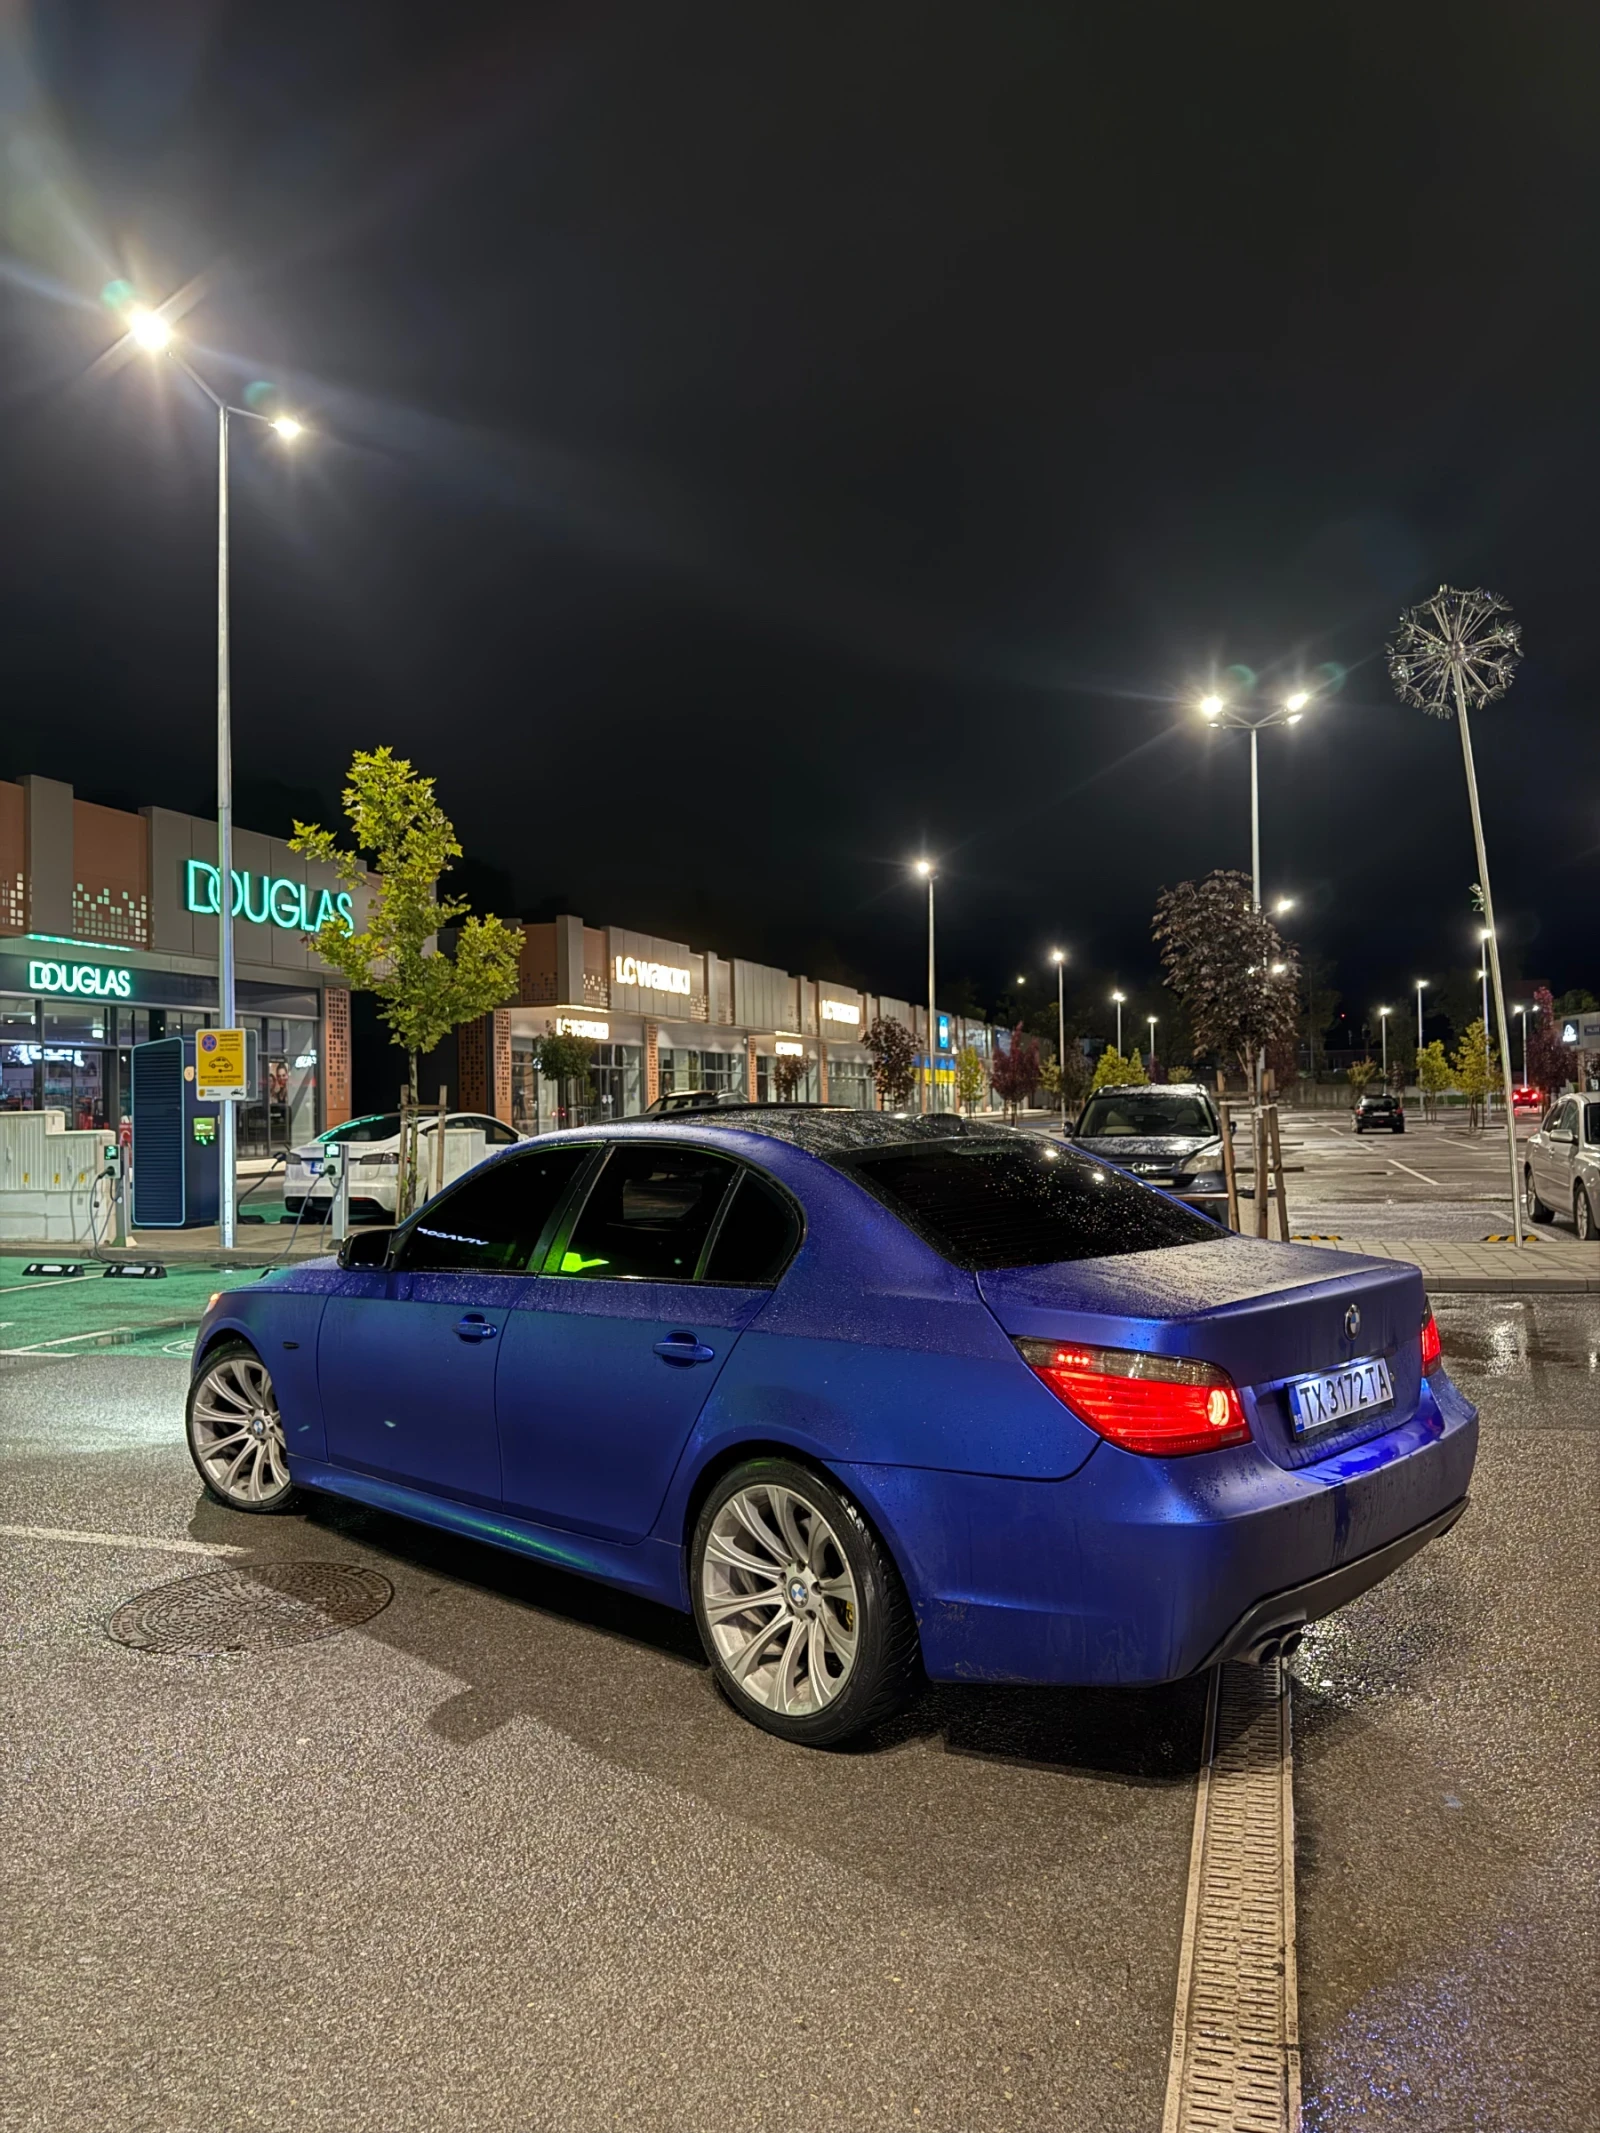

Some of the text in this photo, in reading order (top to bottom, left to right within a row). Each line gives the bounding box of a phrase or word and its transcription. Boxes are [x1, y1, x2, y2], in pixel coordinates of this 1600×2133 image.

[187, 859, 354, 938] DOUGLAS
[29, 960, 131, 997] DOUGLAS
[1299, 1364, 1390, 1425] TX 3172 TA
